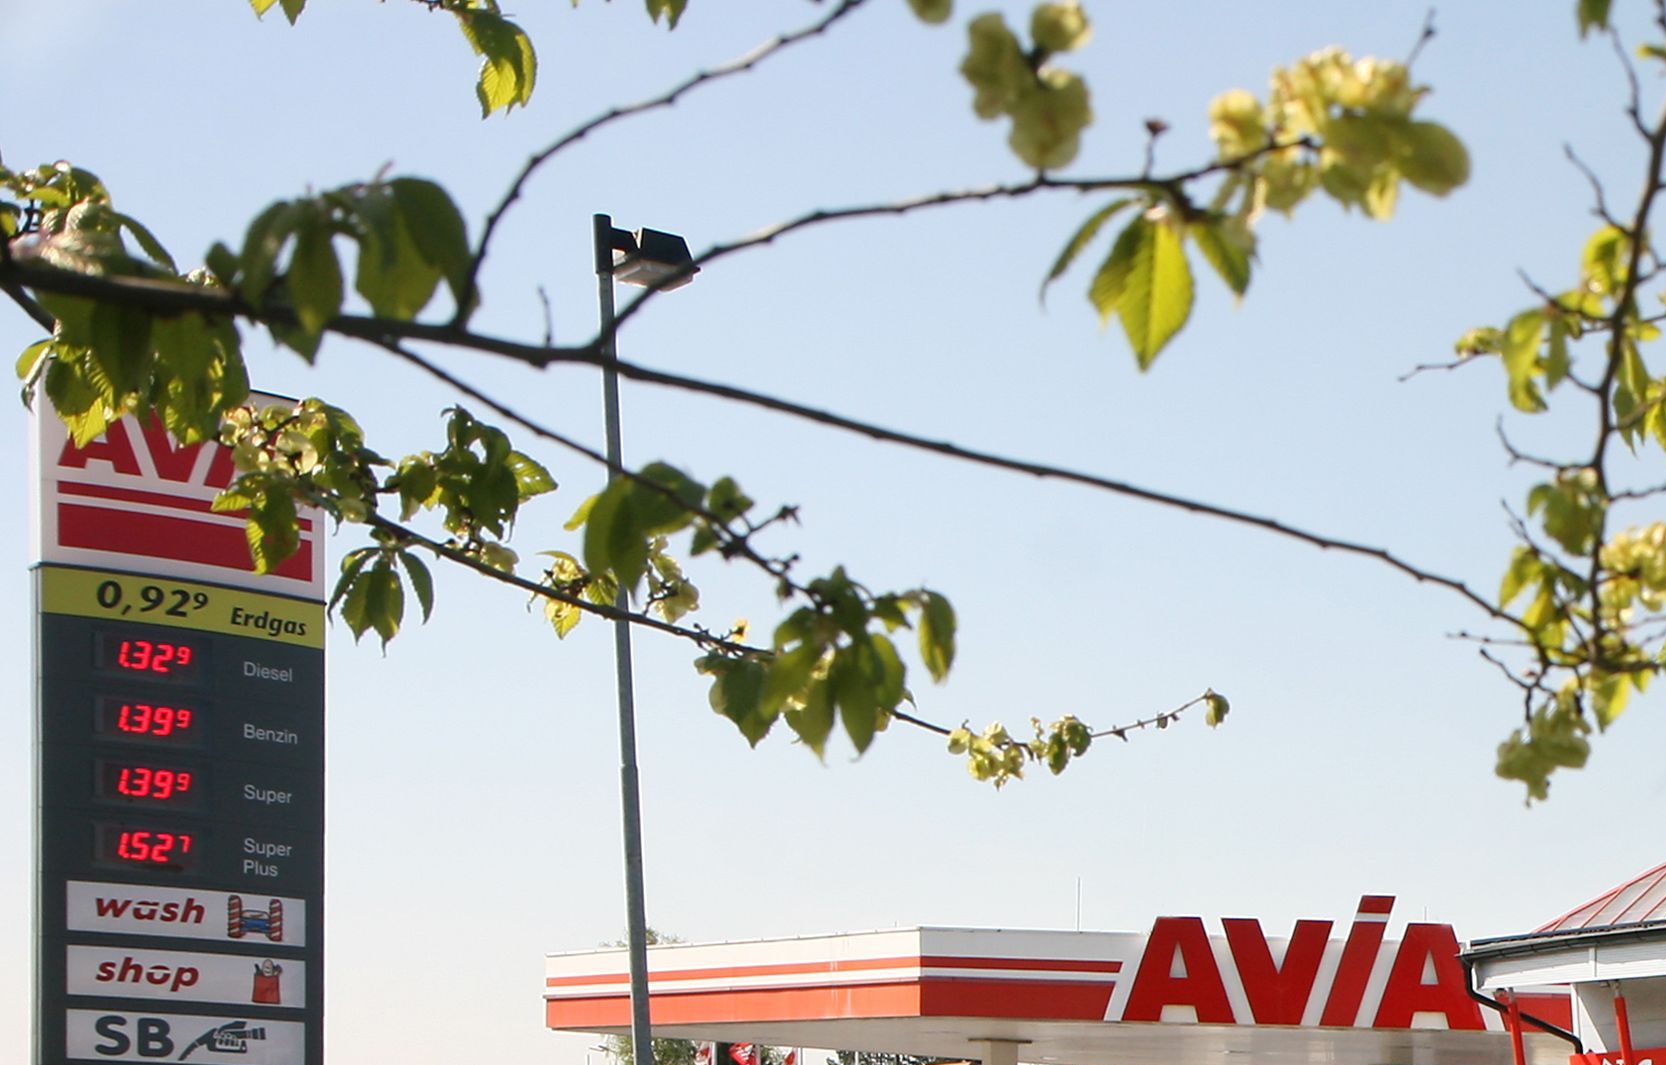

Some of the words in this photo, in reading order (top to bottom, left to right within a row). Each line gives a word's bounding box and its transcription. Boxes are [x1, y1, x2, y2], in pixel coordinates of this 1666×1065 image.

[230, 607, 307, 637] Erdgas
[243, 661, 293, 682] Diesel
[243, 723, 298, 745] Benzin
[243, 784, 292, 804] Super
[243, 838, 292, 857] Super
[243, 859, 279, 877] Plus
[95, 897, 205, 924] wash
[95, 957, 199, 992] shop
[94, 1015, 174, 1059] SB
